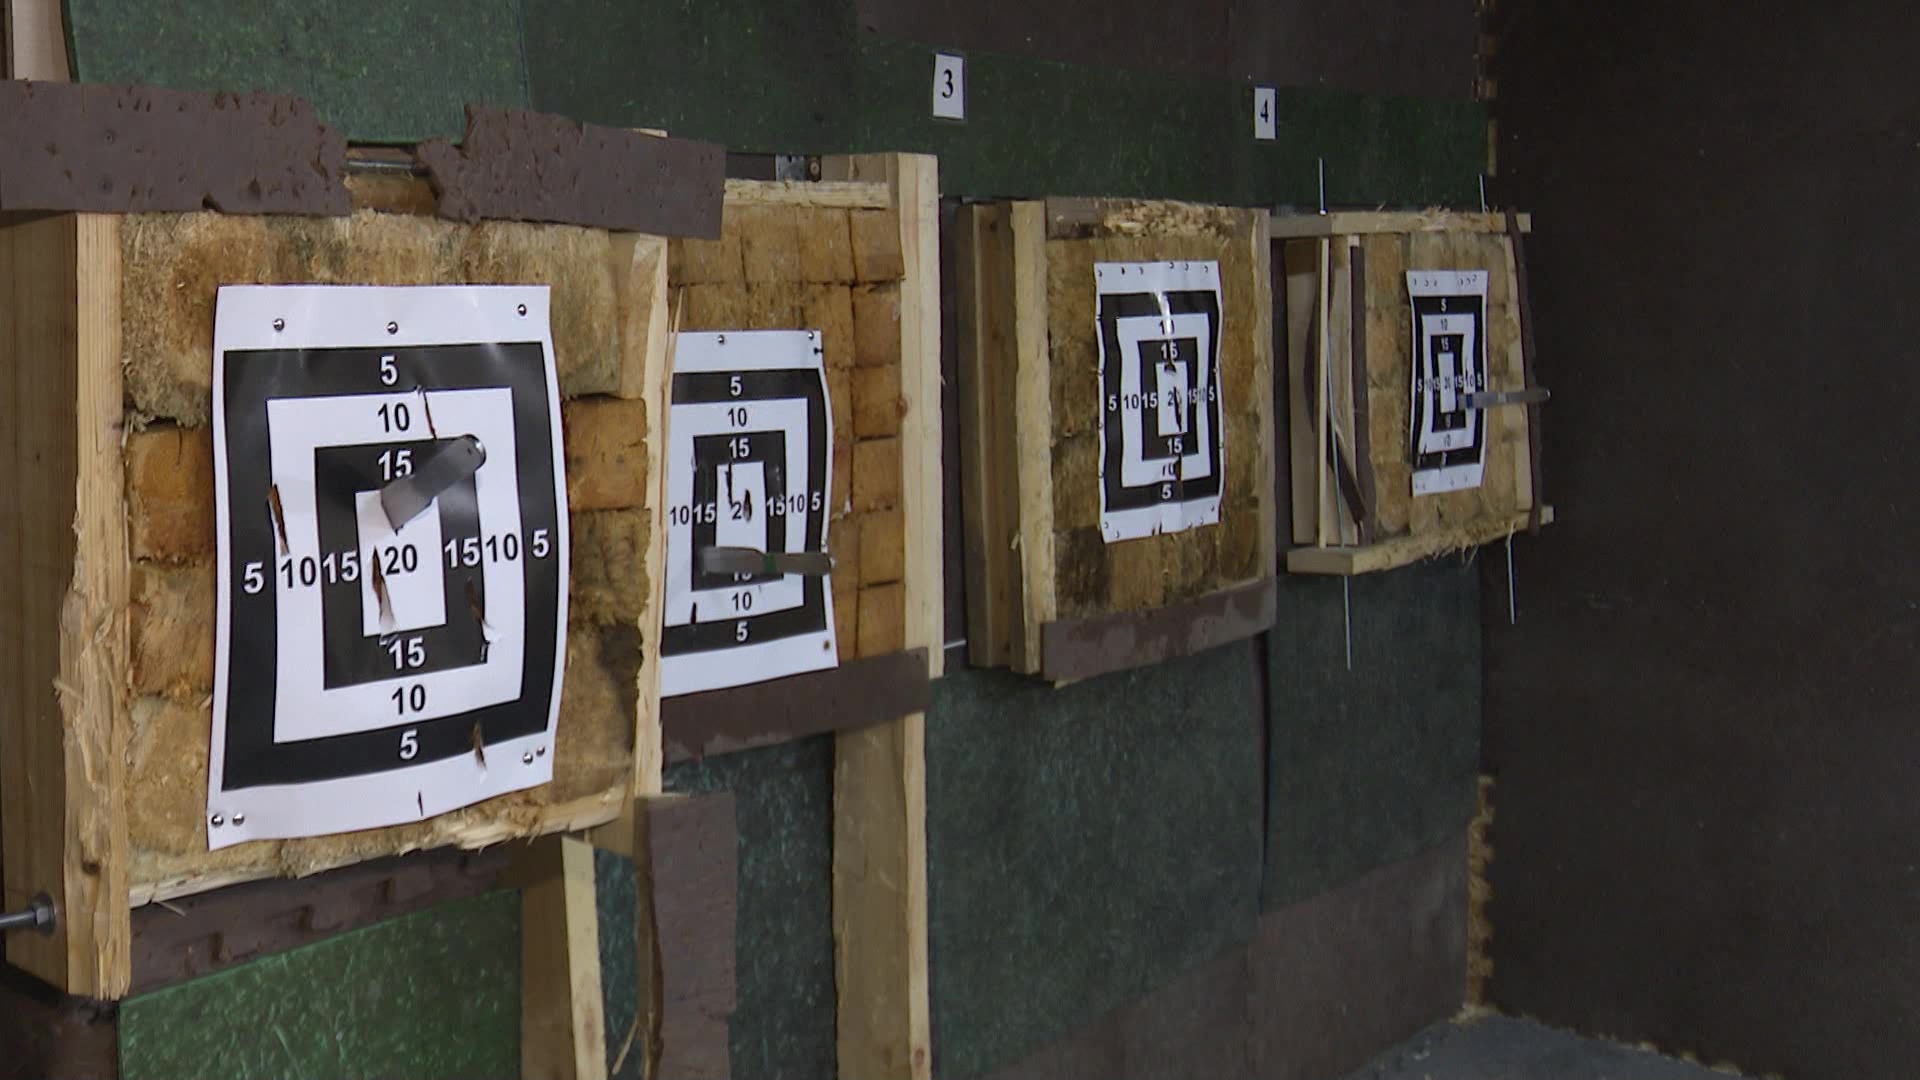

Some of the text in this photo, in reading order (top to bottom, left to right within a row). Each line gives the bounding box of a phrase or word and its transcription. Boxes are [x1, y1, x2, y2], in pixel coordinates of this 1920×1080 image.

[942, 69, 953, 98] 3
[1260, 99, 1269, 123] 4
[1441, 298, 1447, 312] 5
[380, 355, 398, 386] 5
[730, 376, 742, 396] 5
[1109, 395, 1117, 411] 5
[1124, 394, 1139, 409] 10
[1142, 392, 1158, 408] 15
[1188, 388, 1197, 405] 15
[1208, 386, 1215, 401] 5
[377, 403, 410, 433] 10
[727, 408, 747, 427] 10
[729, 438, 750, 458] 15
[1167, 438, 1183, 453] 15
[377, 450, 413, 481] 15
[1161, 484, 1172, 499] 5
[669, 505, 689, 526] 10
[693, 503, 716, 523] 15
[766, 496, 785, 517] 15
[789, 494, 805, 513] 10
[811, 492, 821, 510] 5
[243, 529, 550, 594] 5 10 15 20 15 10 5
[732, 592, 752, 611] 10
[736, 621, 748, 642] 5
[388, 637, 425, 669] 15
[392, 684, 426, 715] 10
[399, 729, 419, 760] 5
